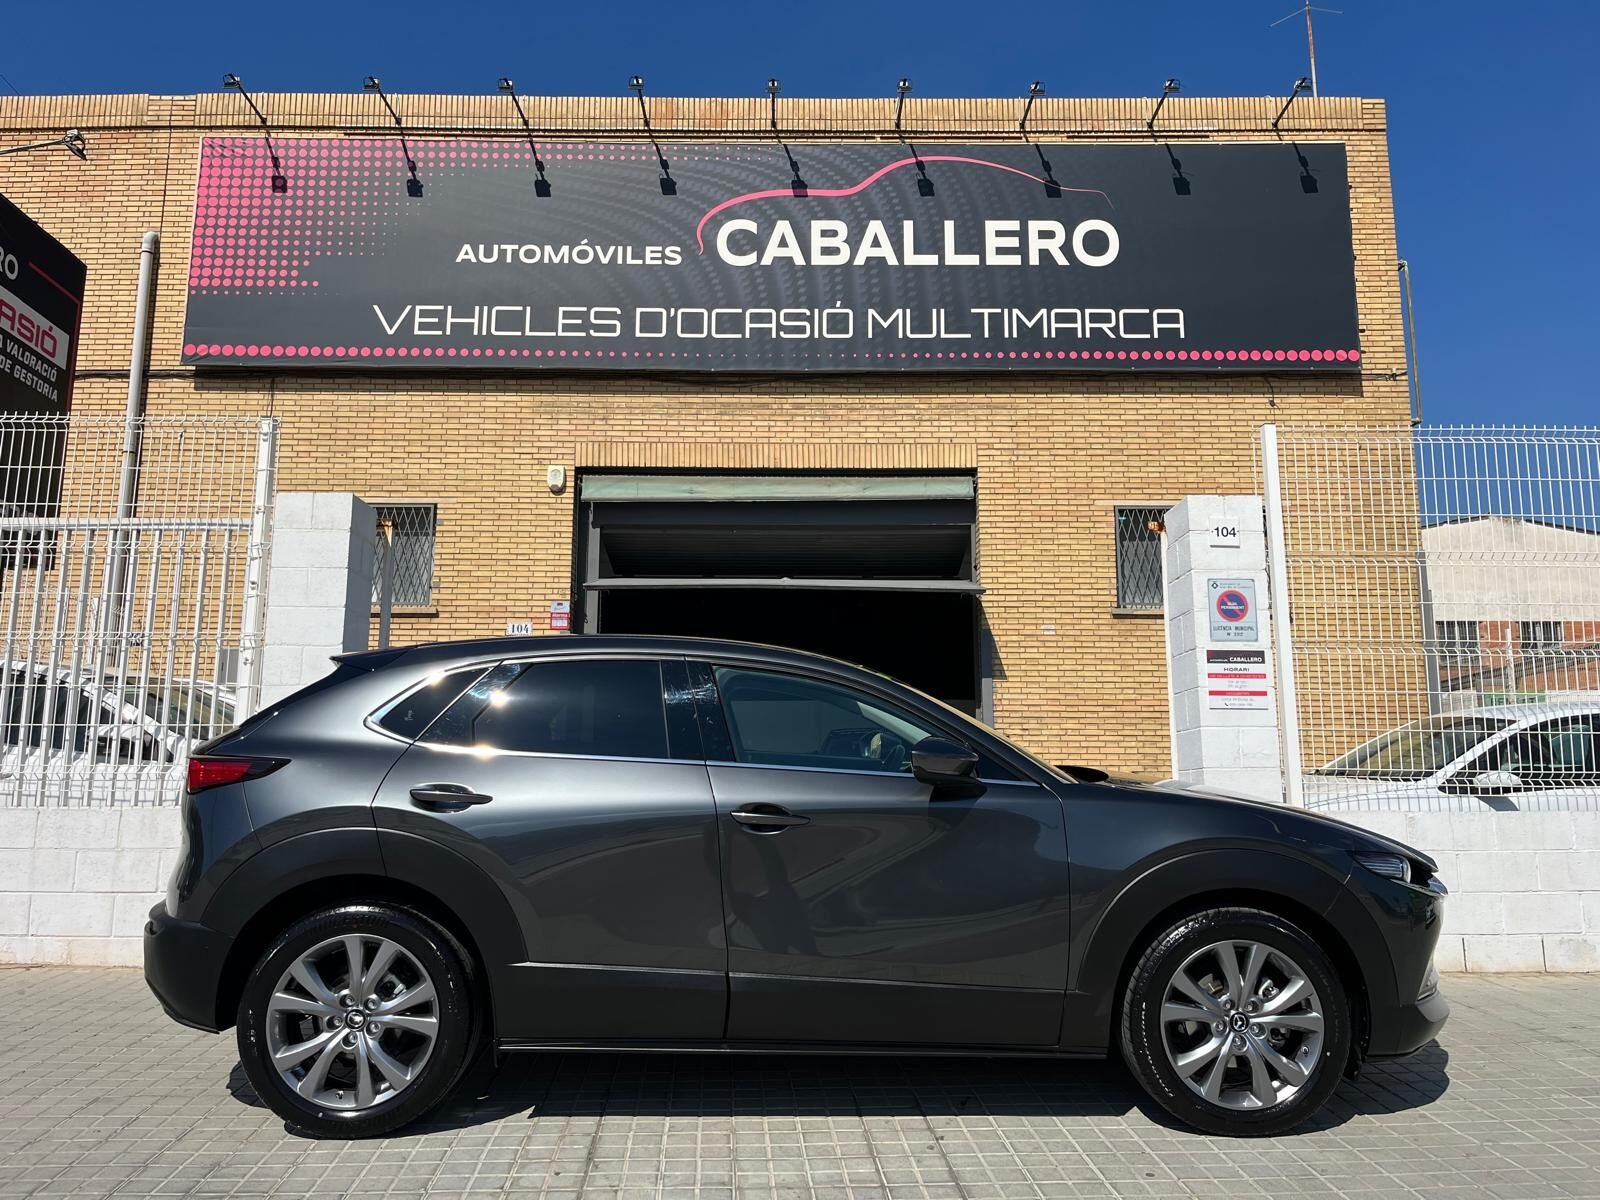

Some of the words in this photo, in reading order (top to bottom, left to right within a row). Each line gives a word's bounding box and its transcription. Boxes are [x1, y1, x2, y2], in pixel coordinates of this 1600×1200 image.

[455, 238, 683, 266] AUTOMÓVILES
[716, 218, 1121, 268] CABALLERO
[373, 304, 622, 337] VEHICLES
[635, 300, 854, 339] D'OCASIÓ
[867, 308, 1186, 340] MULTIMARCA
[6, 339, 58, 383] VALORACIÓ
[13, 364, 59, 403] GESTORIA
[1213, 526, 1238, 538] 104
[511, 623, 529, 634] 104
